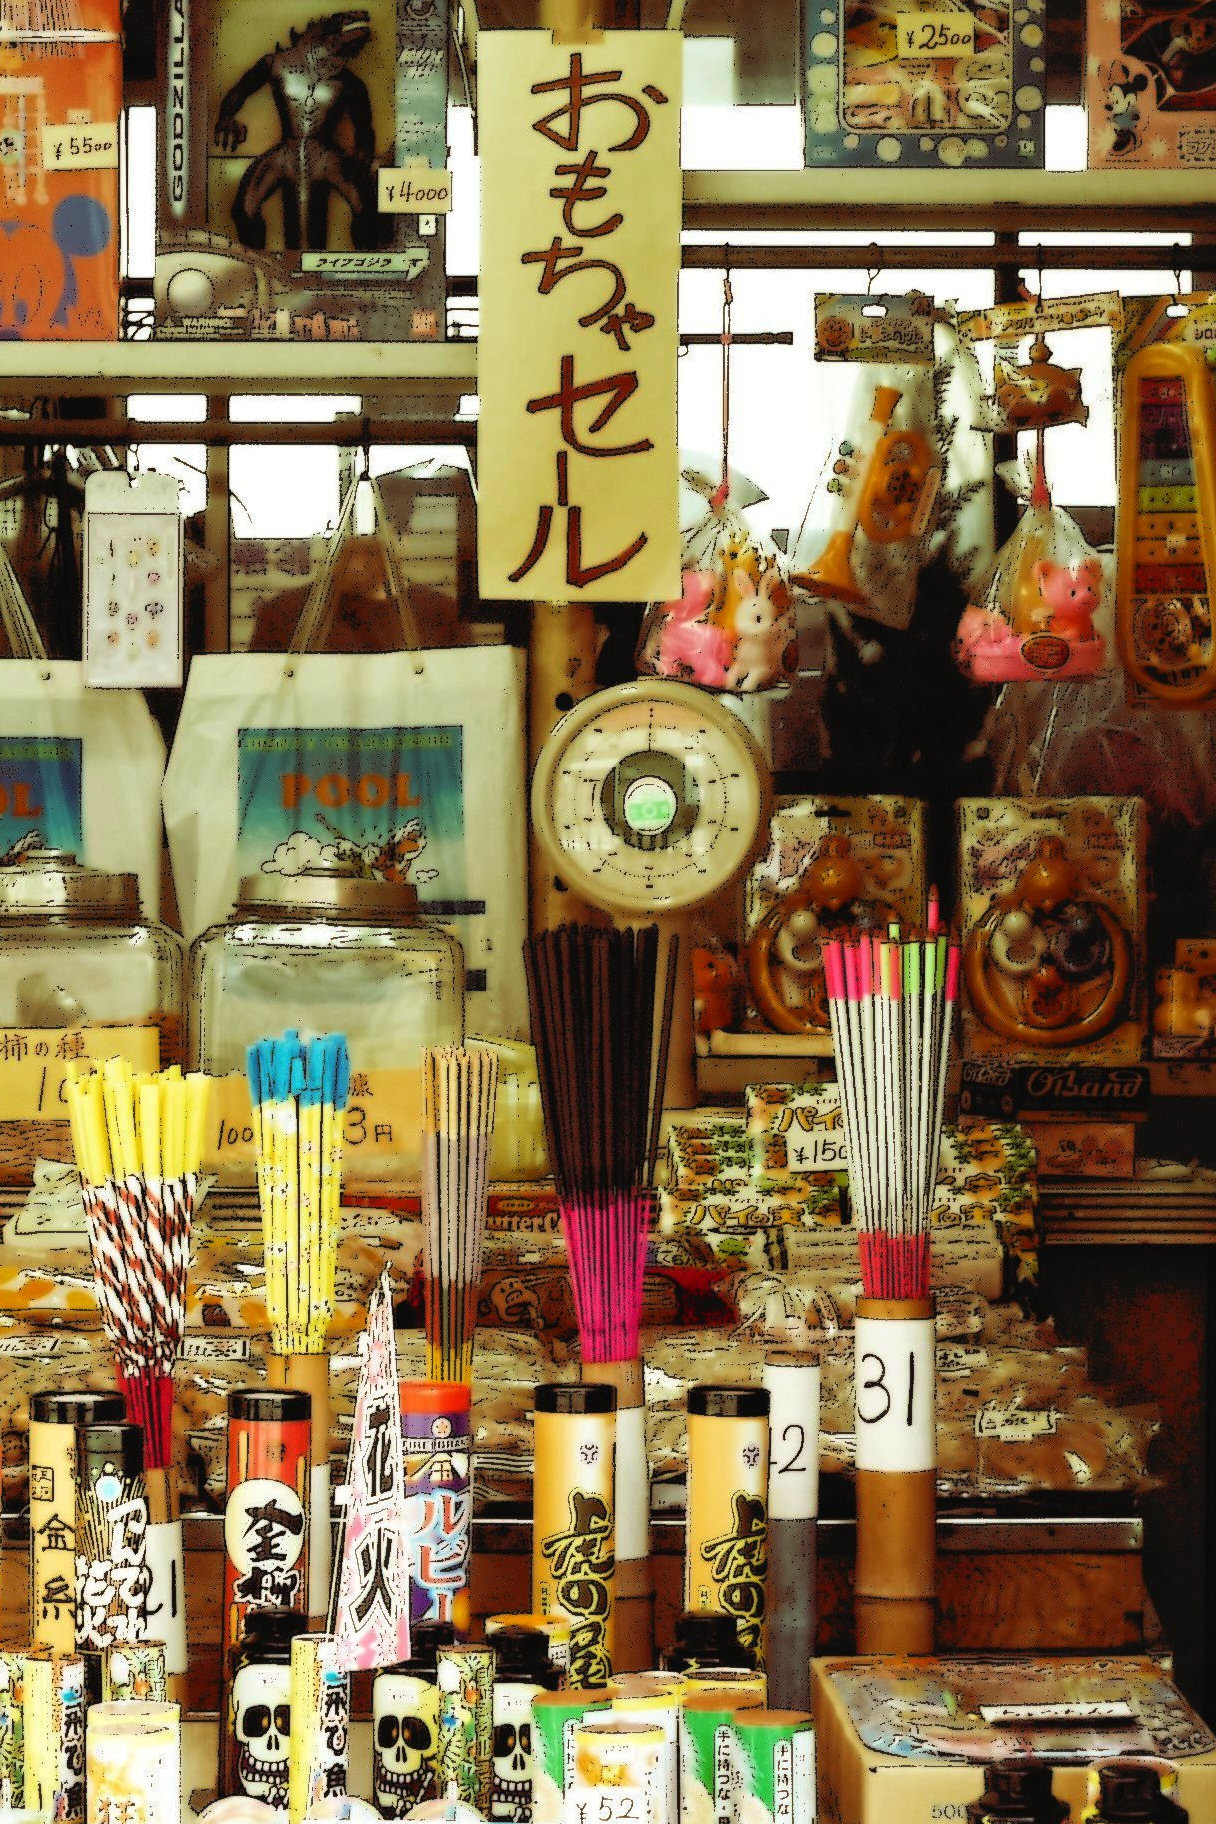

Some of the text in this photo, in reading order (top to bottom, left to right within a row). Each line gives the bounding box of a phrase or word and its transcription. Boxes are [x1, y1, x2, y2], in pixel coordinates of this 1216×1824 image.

[906, 24, 972, 49] ¥2500
[171, 0, 185, 202] GODZILLA
[55, 138, 113, 160] ¥5500
[385, 181, 448, 203] ¥4000
[507, 52, 668, 587] おもちゃセール
[280, 772, 422, 810] POOL
[857, 1351, 915, 1427] 31
[415, 1493, 468, 1622] ルビー
